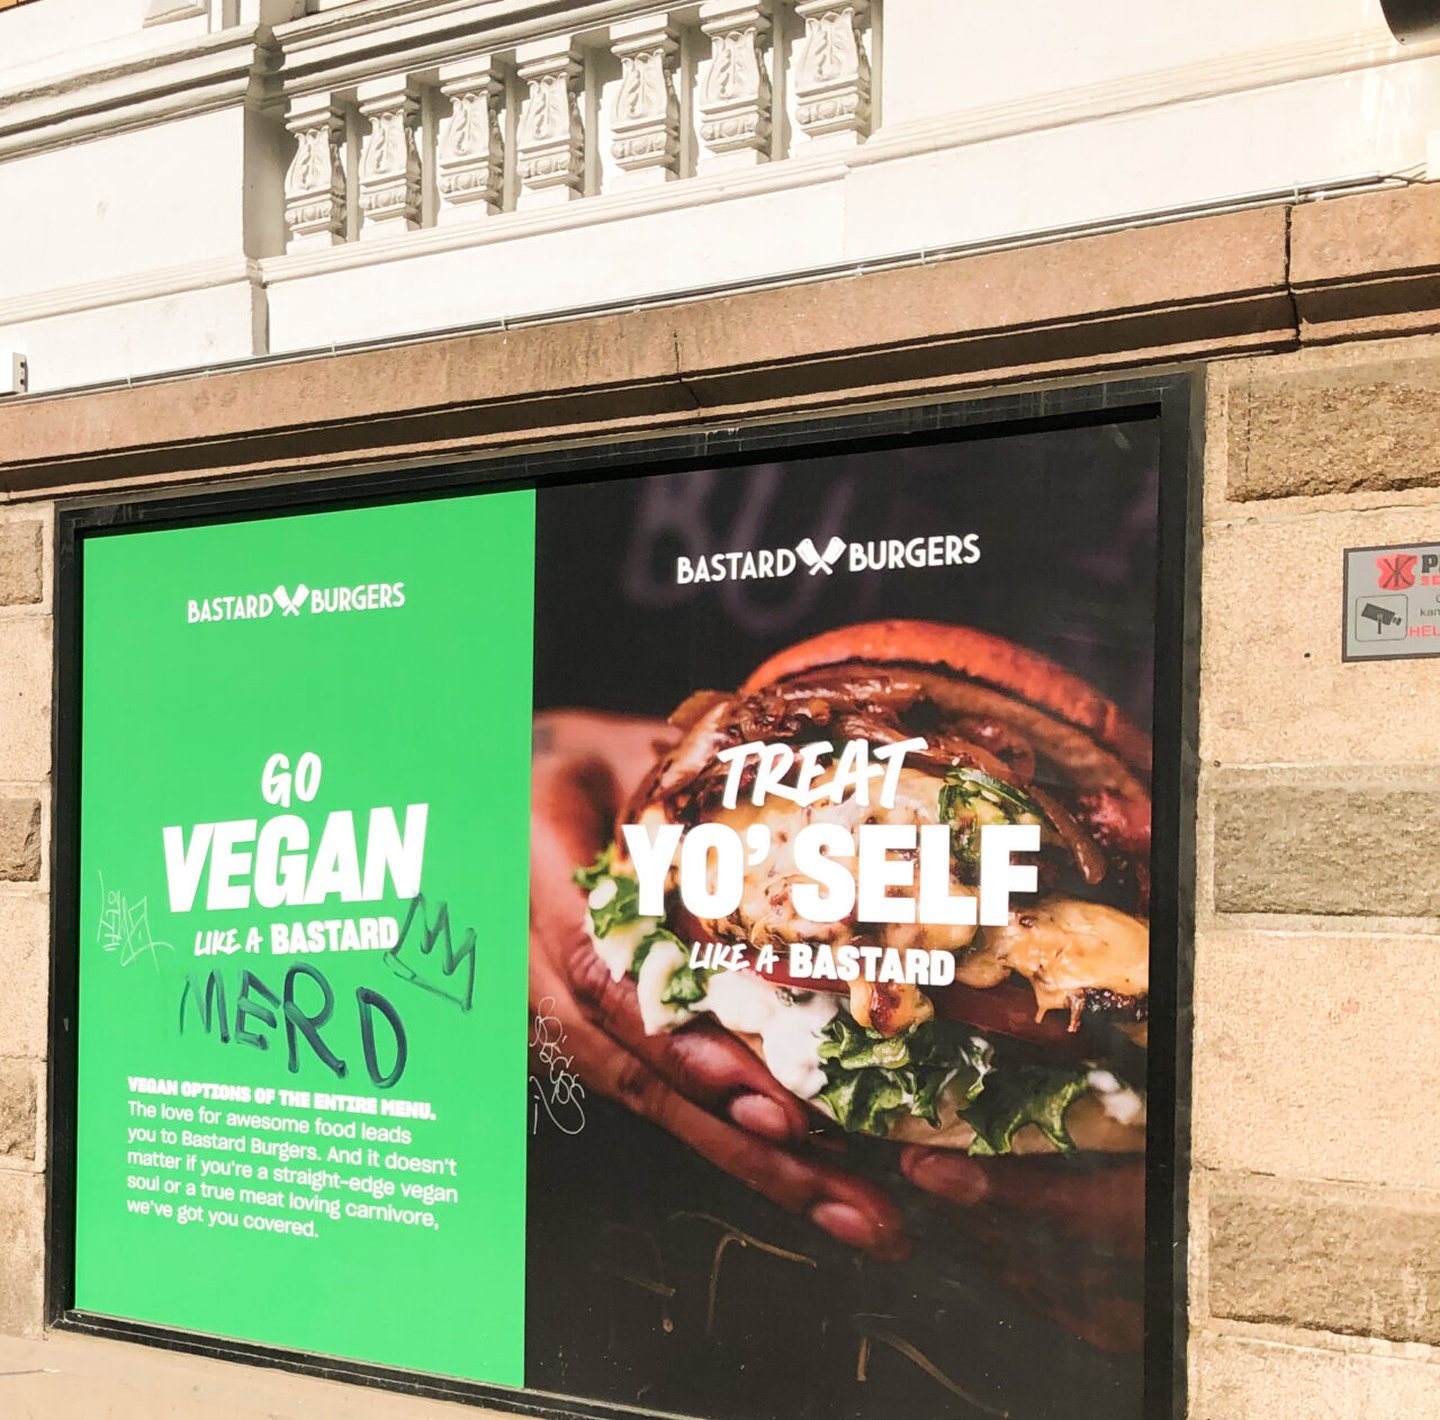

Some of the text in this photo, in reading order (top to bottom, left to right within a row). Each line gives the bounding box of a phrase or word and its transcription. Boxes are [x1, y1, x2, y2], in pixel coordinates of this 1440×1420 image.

[676, 533, 981, 584] BASTARD BURGERS
[187, 582, 406, 624] BASTARD BURGERS
[261, 752, 322, 808] GO
[717, 736, 928, 810] TREAT
[162, 803, 429, 913] VEGAN
[791, 823, 1041, 927] SELF
[194, 916, 399, 957] LIKE A BASTARD
[688, 941, 956, 987] LIKE A BASTARD
[128, 1076, 437, 1120] VEGAN OPTIONS OF THE ENTIRE MENU.
[128, 1100, 412, 1144] The love for awesome food leads
[128, 1127, 457, 1176] you to Bastard Burgers. And it doesn't
[127, 1174, 439, 1230] soul or a true meat loving carnivore,
[128, 1151, 458, 1205] matter if you're a straight-edge vegan
[127, 1200, 319, 1238] we've got you covered.
